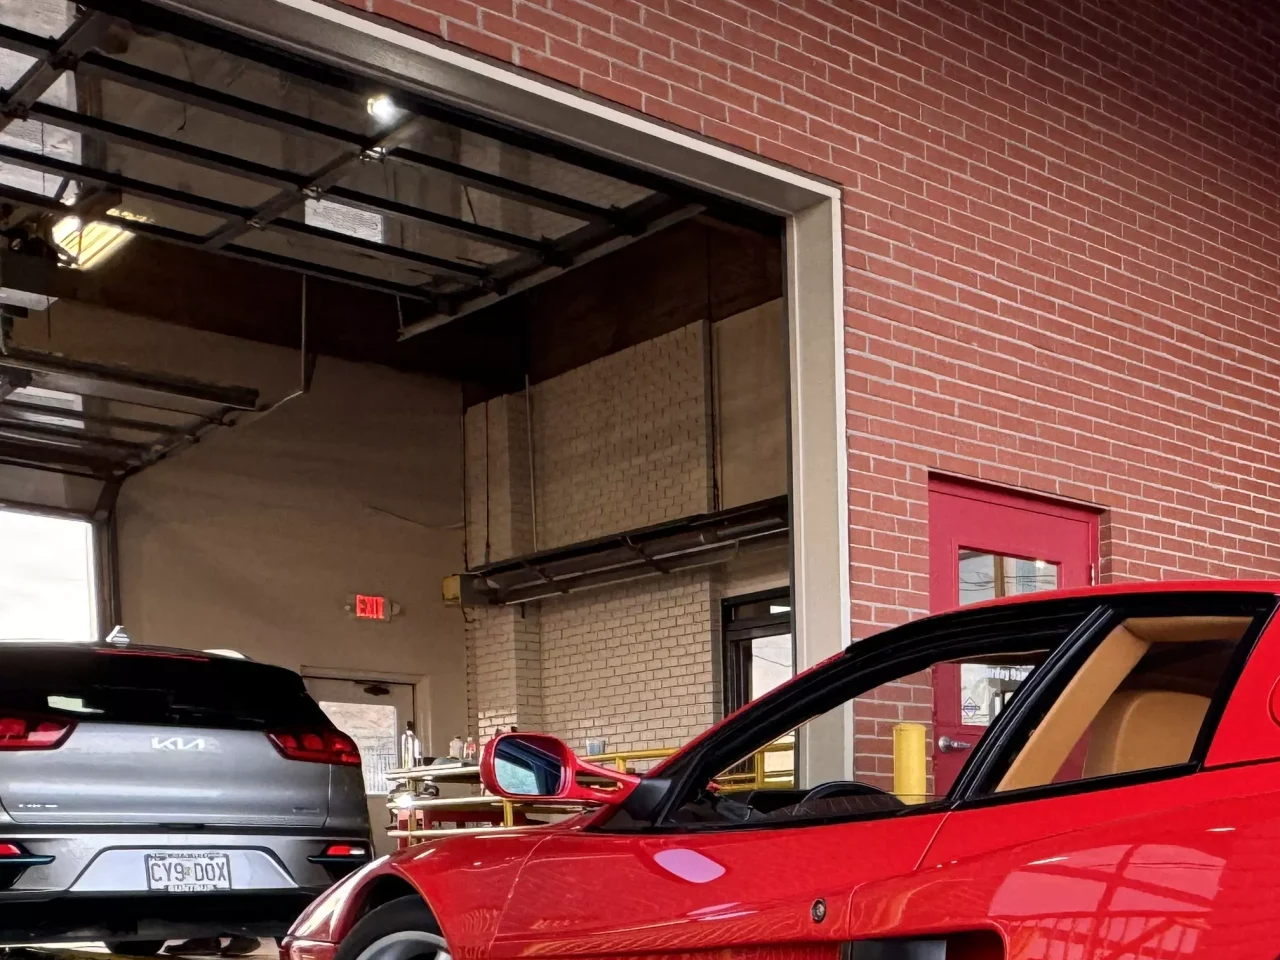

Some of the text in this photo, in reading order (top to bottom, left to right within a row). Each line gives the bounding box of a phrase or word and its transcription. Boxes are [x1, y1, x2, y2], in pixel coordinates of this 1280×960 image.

[356, 594, 385, 619] EXIT
[152, 736, 206, 751] KIA
[150, 862, 186, 882] CY9
